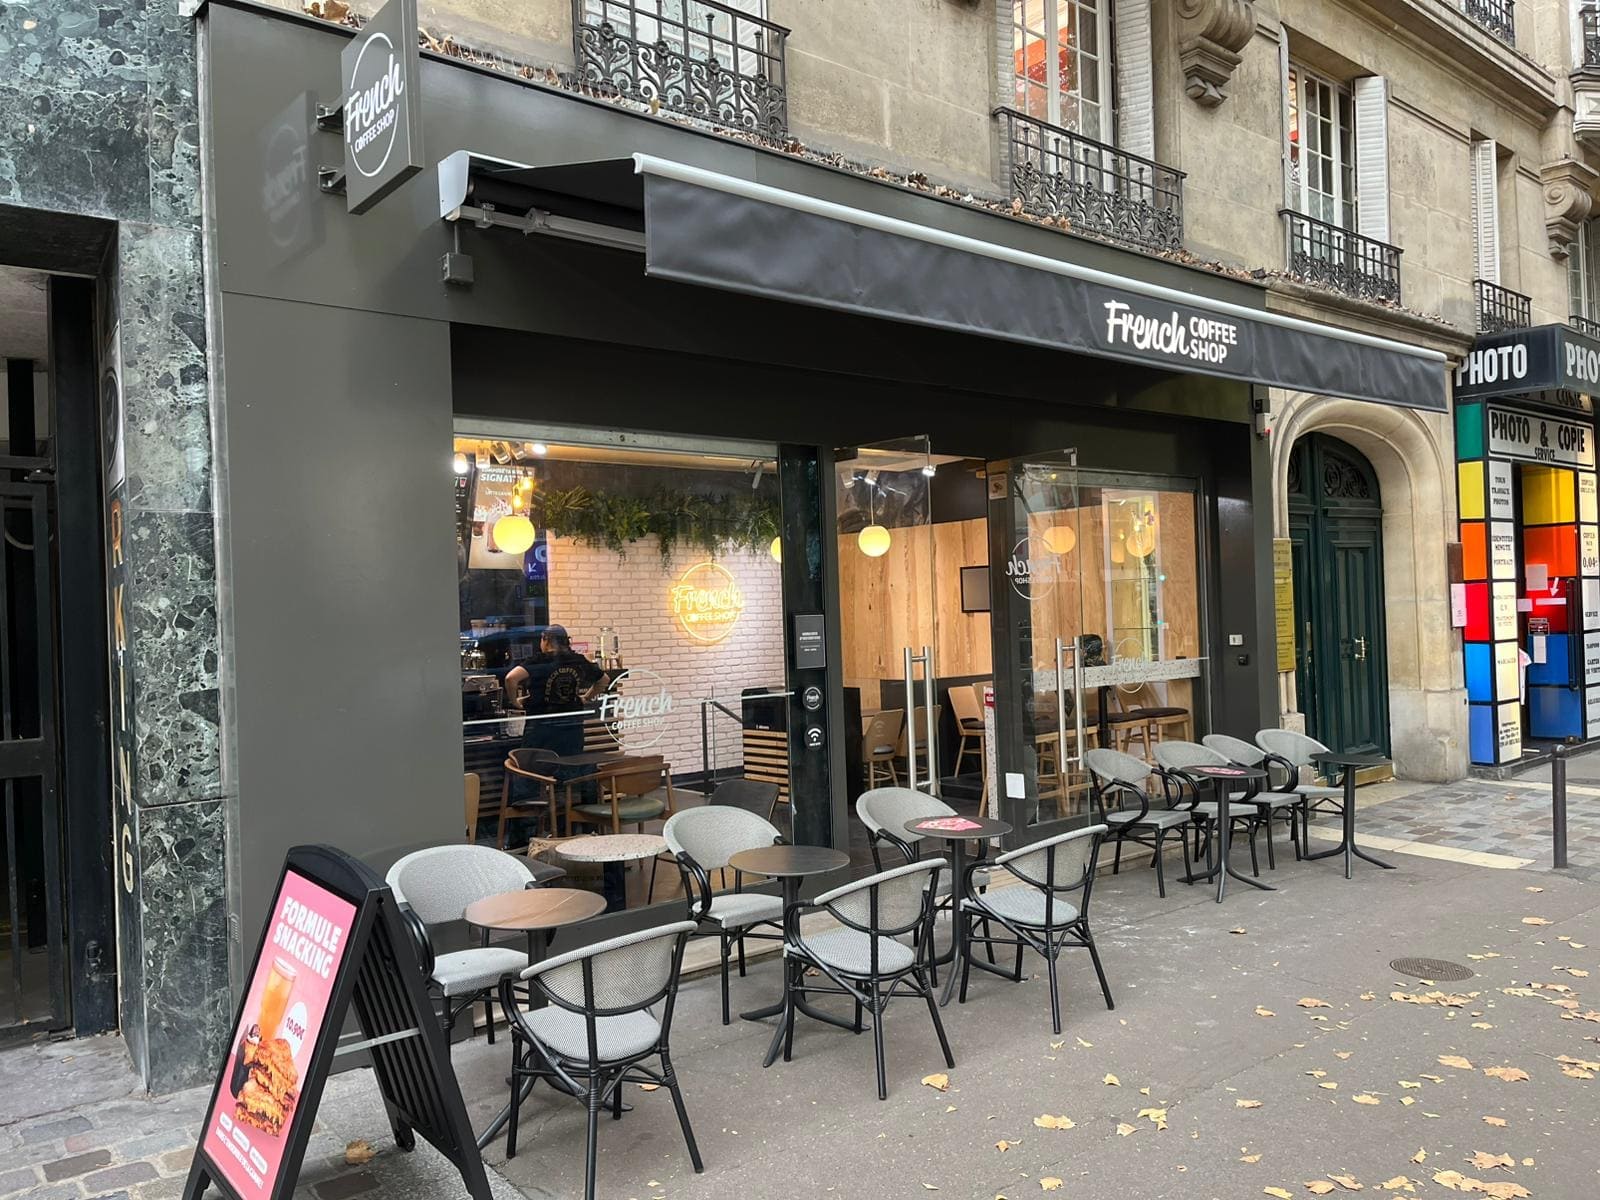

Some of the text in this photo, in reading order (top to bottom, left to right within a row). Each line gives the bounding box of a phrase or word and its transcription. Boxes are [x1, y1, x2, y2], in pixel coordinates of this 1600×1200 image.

[344, 53, 404, 143] French
[354, 108, 396, 154] COFFEE SHOP
[1104, 299, 1189, 355] French
[1189, 316, 1238, 345] COFFEE
[1189, 338, 1228, 364] SHOP
[1455, 343, 1528, 388] PHOTO
[1565, 341, 1600, 384] PHO
[1491, 411, 1585, 453] PHOTO & COPIE
[1534, 447, 1556, 462] SERVICE
[671, 581, 745, 614] French
[598, 687, 677, 721] French
[611, 720, 642, 731] COFFEE
[279, 896, 343, 954] FORMULE
[273, 921, 334, 980] SNACKING
